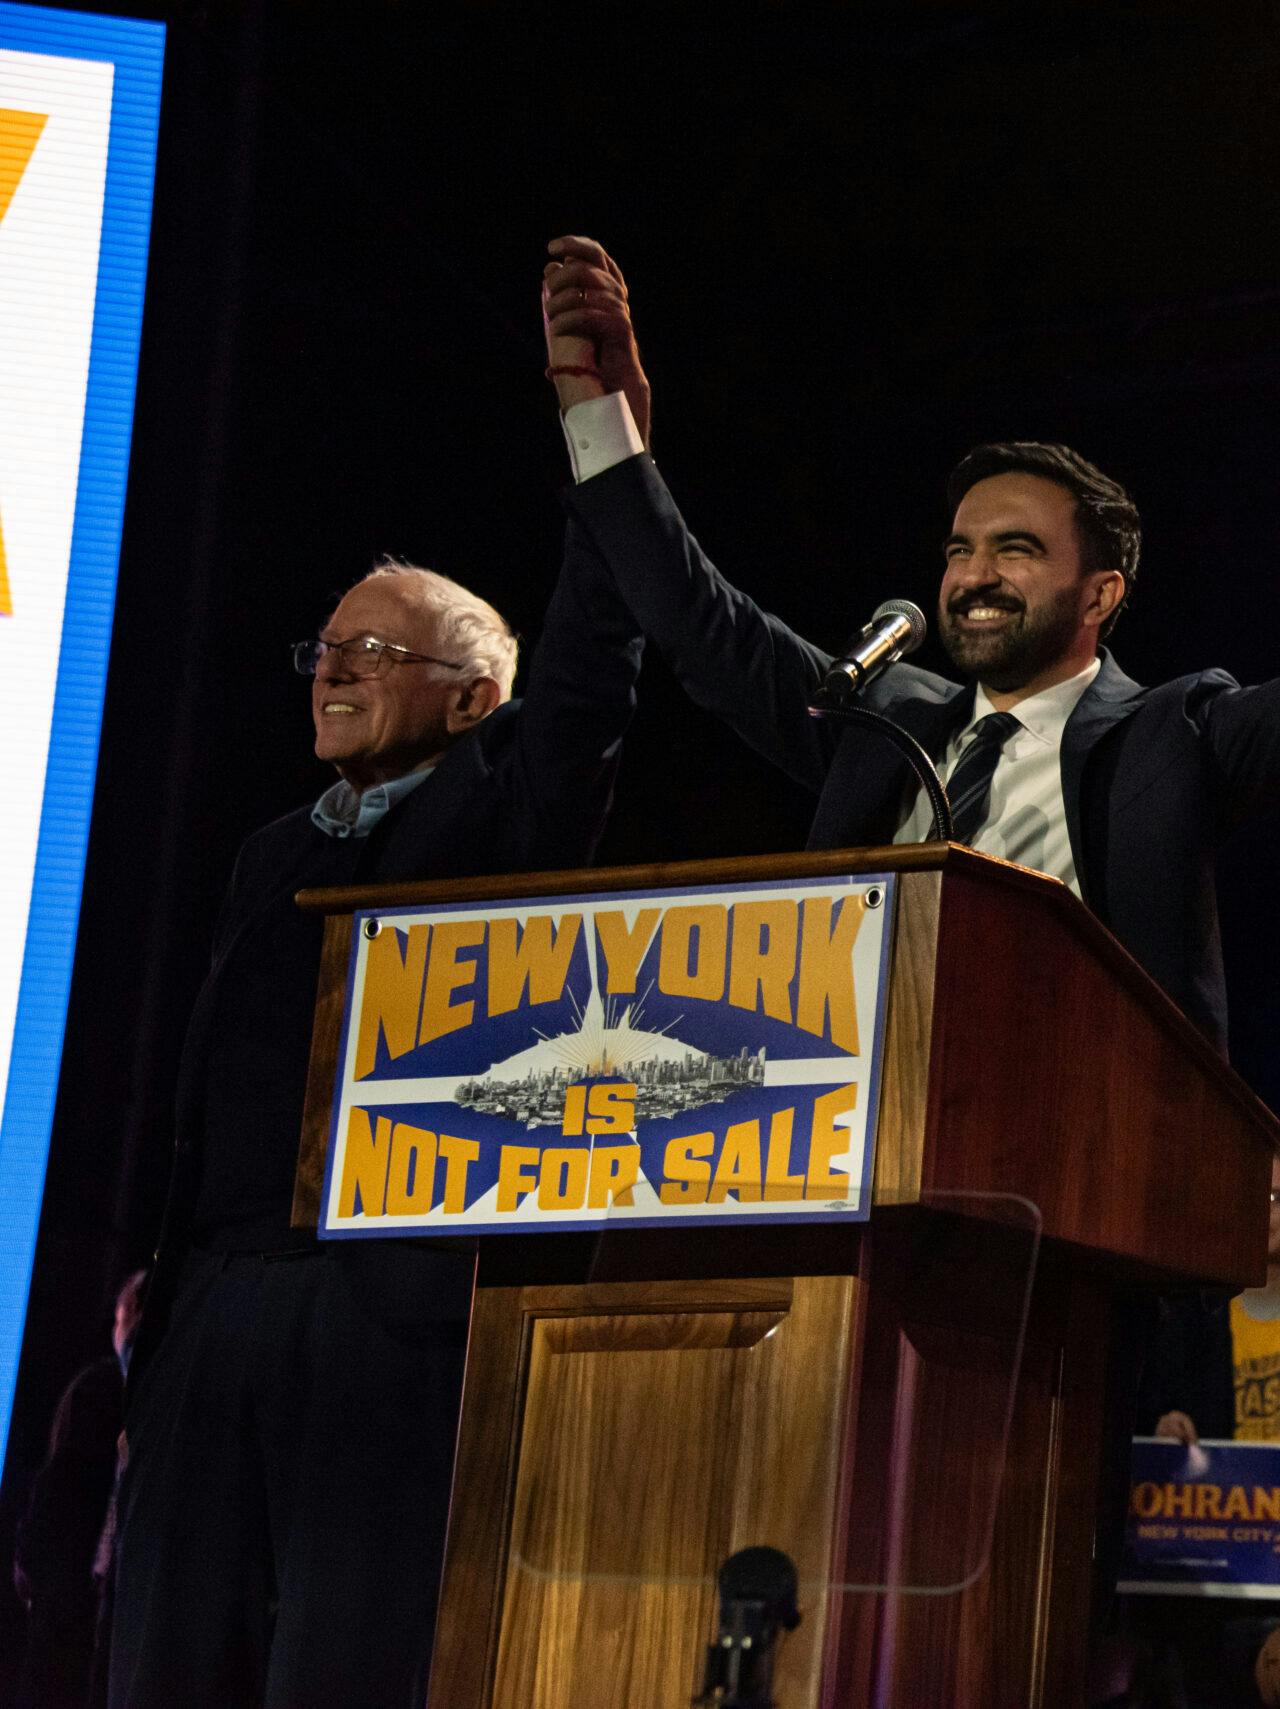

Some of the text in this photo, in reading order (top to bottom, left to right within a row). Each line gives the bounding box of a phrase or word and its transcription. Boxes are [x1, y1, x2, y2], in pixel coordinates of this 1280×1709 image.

[354, 894, 865, 1082] NEW YORK
[337, 1081, 859, 1219] NOT FOR SALE
[561, 1082, 637, 1137] IS
